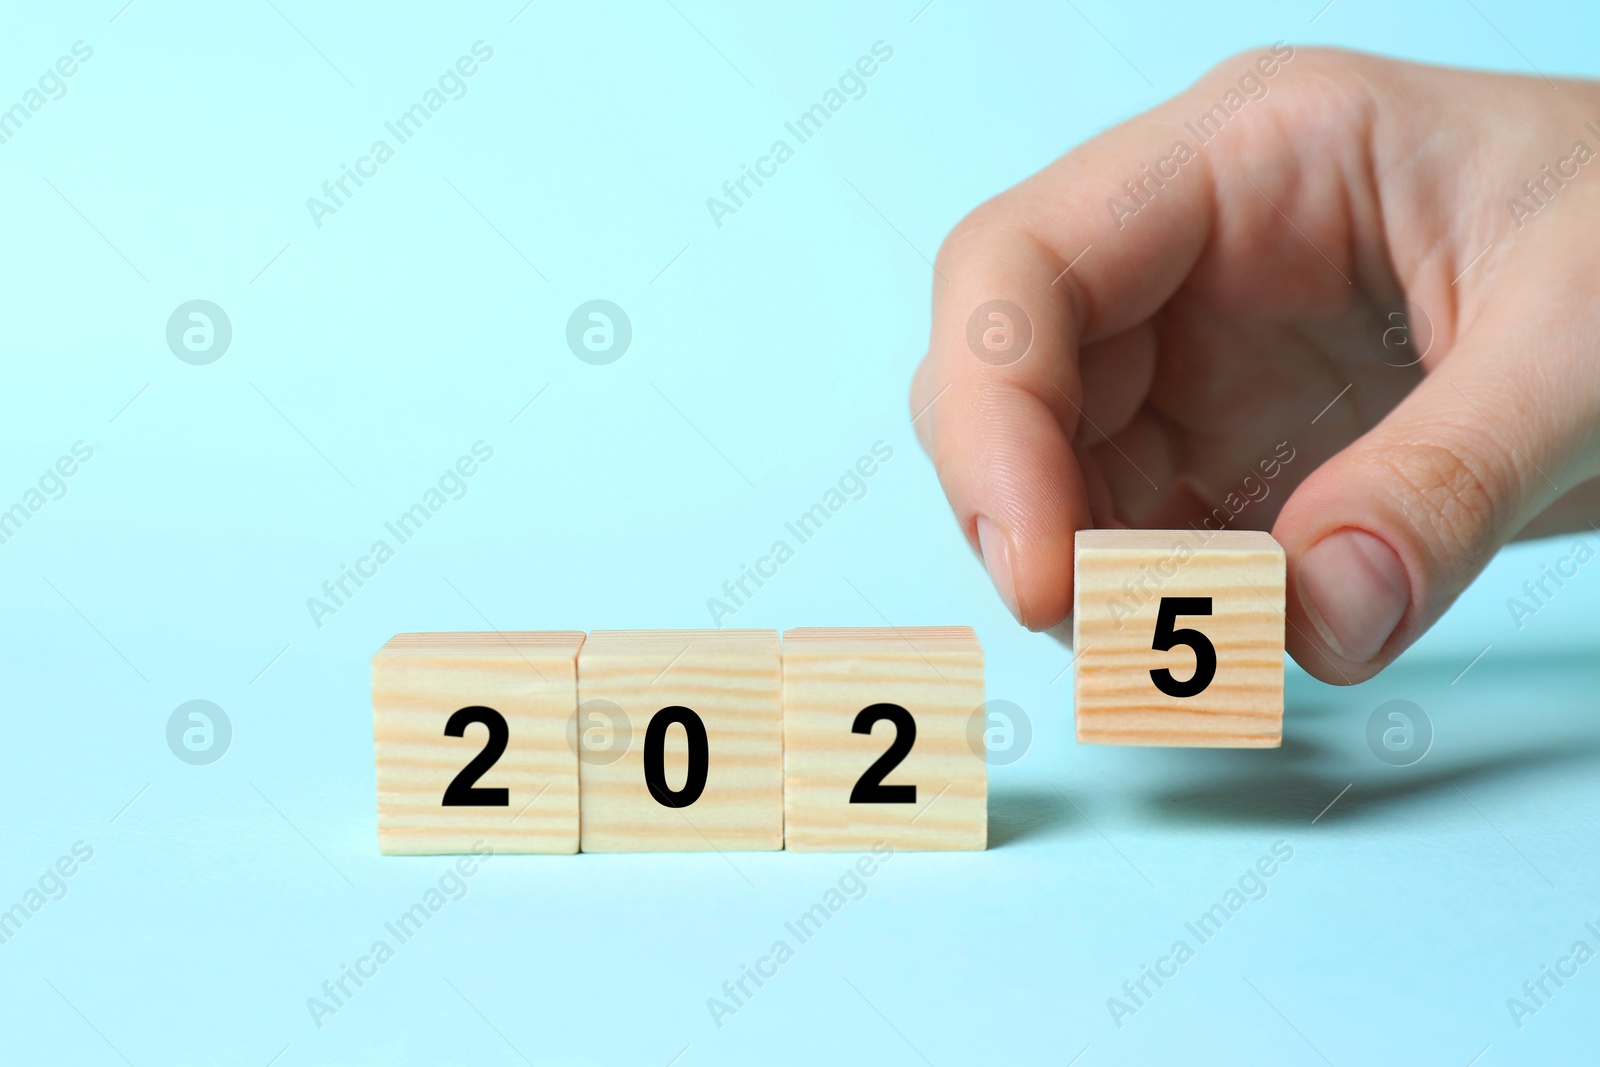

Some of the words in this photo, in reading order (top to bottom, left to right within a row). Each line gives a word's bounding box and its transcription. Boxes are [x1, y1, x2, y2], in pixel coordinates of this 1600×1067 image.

[1150, 597, 1217, 698] 5
[442, 706, 509, 807] 2
[643, 706, 709, 809] 0
[850, 703, 917, 804] 2
